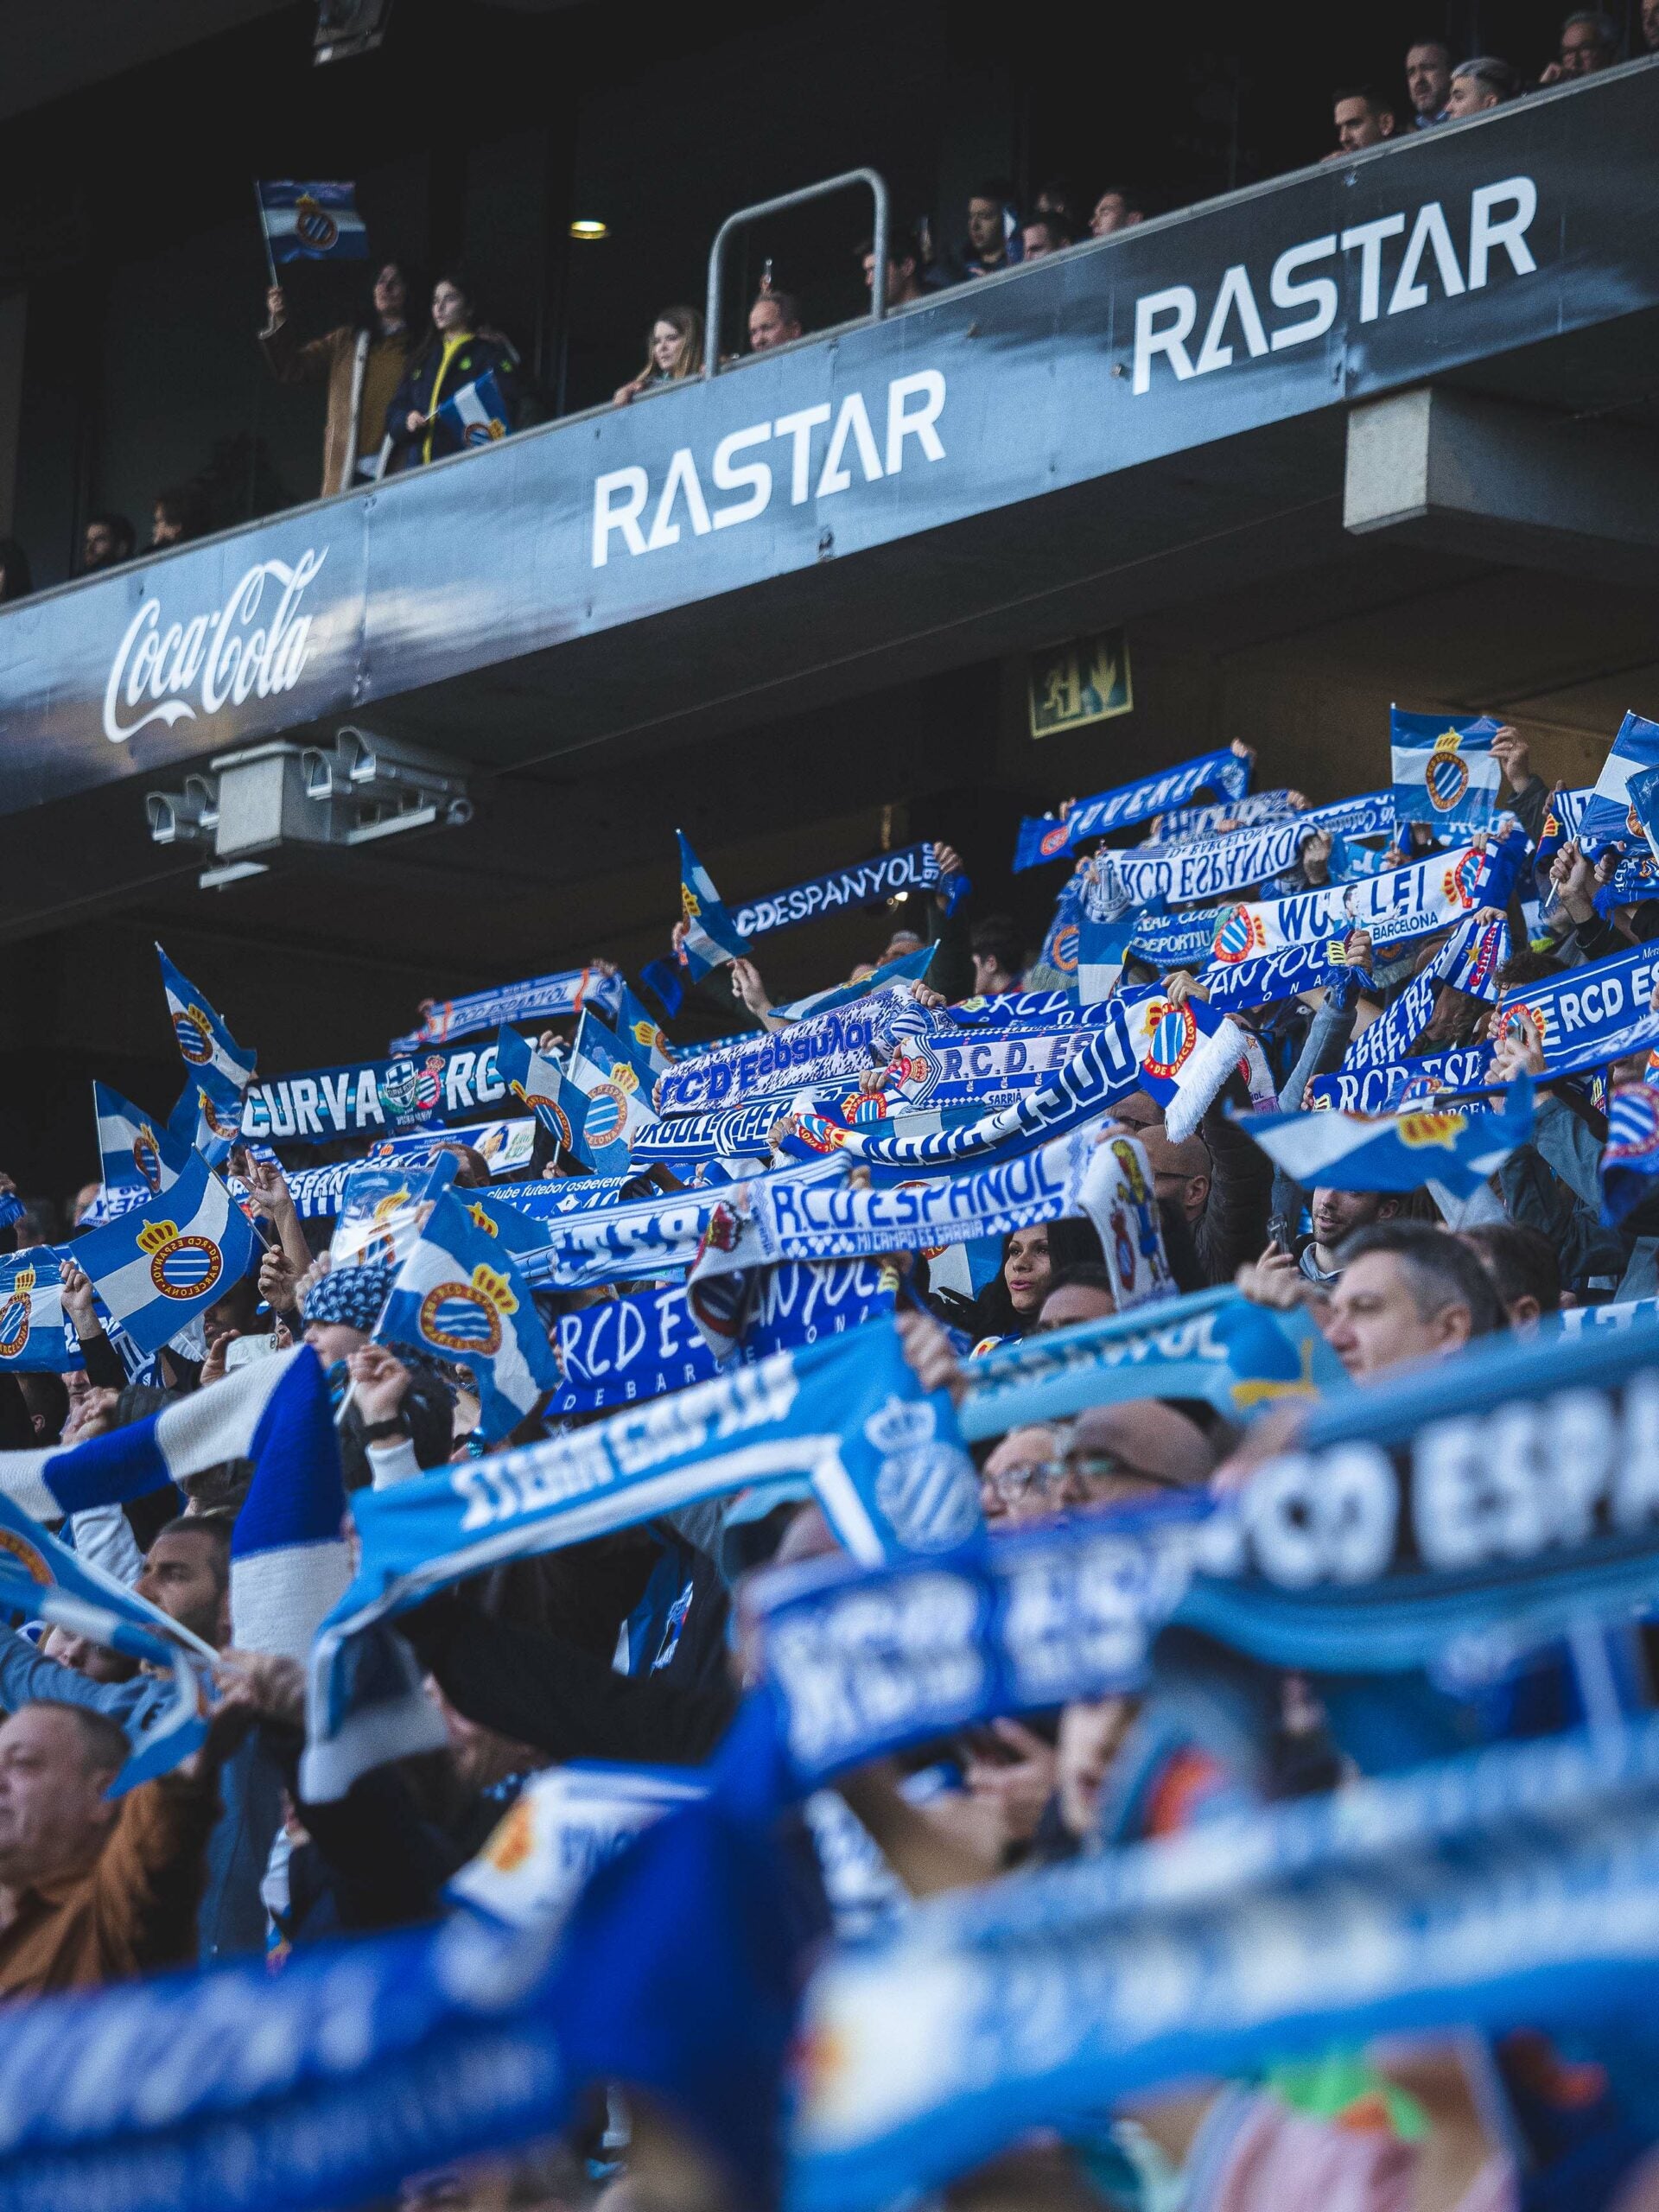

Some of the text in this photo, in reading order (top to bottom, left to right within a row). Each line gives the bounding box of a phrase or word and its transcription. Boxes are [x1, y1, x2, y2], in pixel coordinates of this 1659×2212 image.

[1133, 176, 1537, 395] RASTAR
[593, 369, 946, 568] RASTAR
[1278, 865, 1426, 941] WU LEI
[1373, 912, 1439, 940] BARCELONA
[1560, 978, 1624, 1033] RCD
[242, 1045, 508, 1137] CURVA RC
[520, 1180, 568, 1198] futebol
